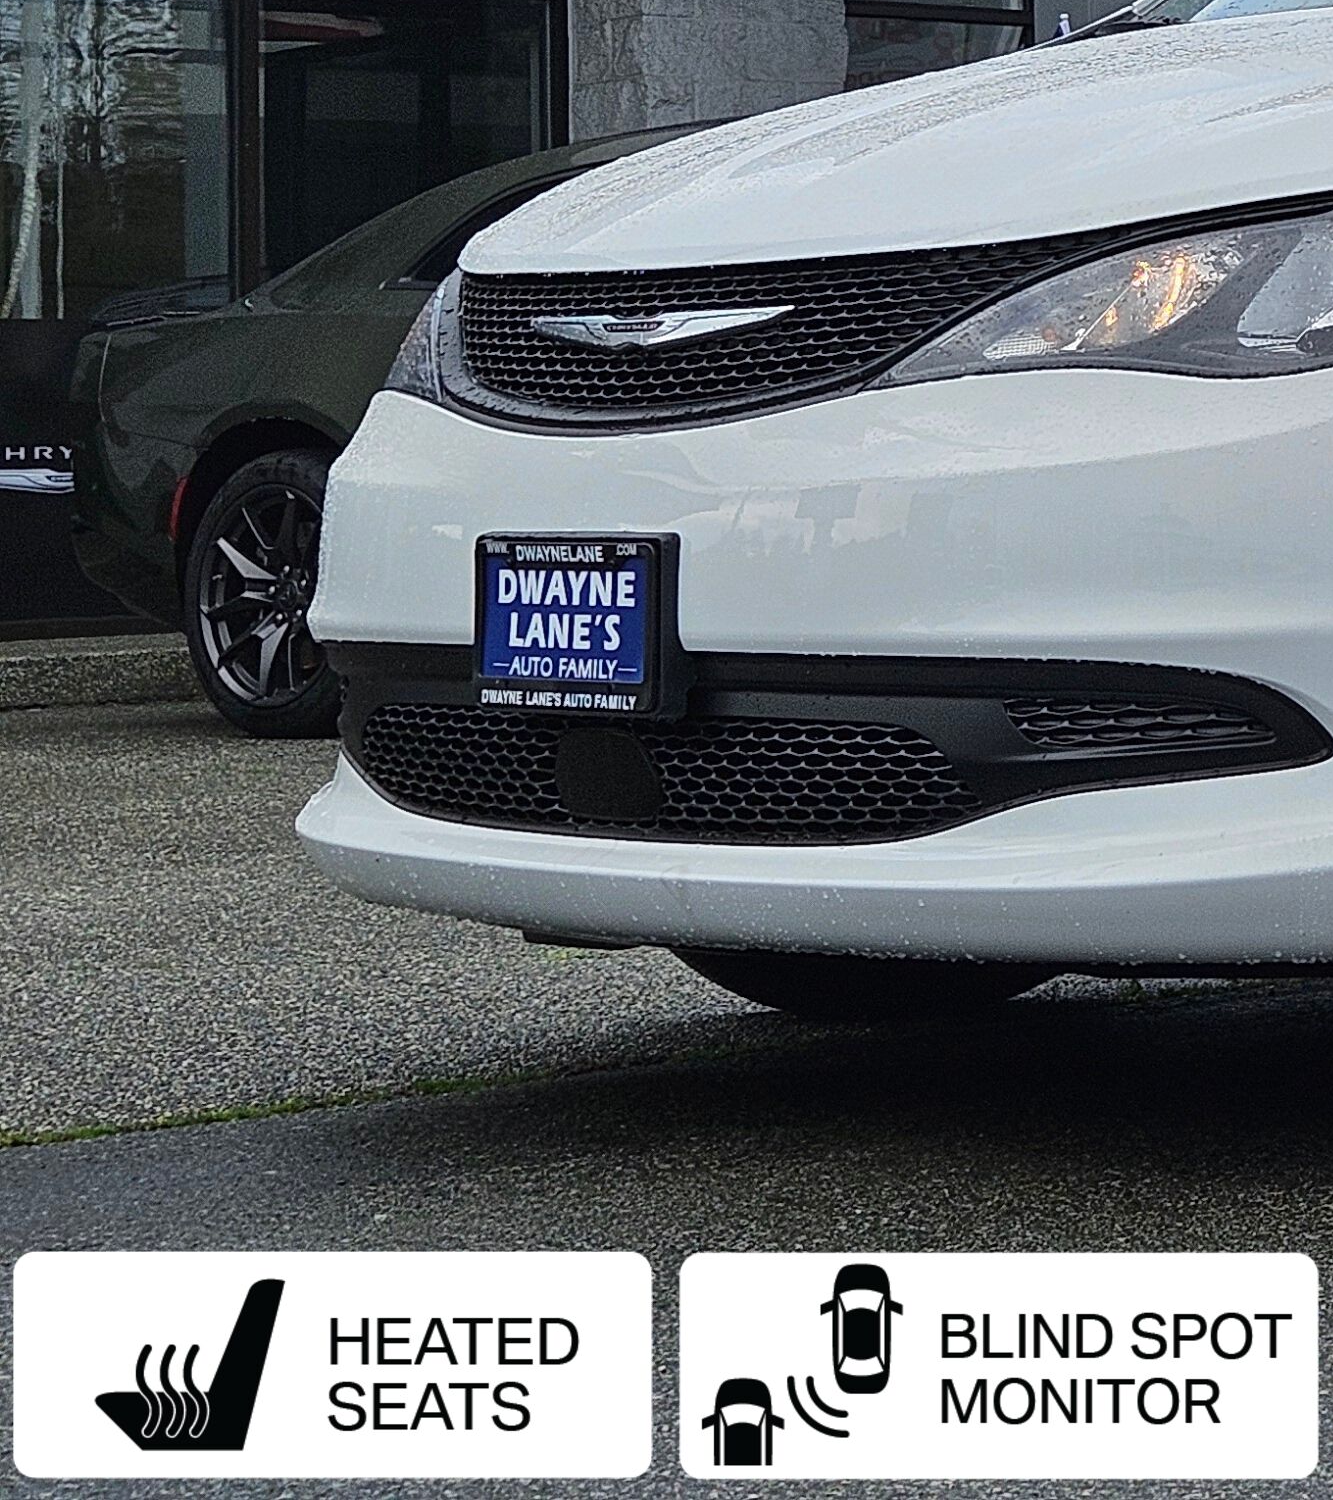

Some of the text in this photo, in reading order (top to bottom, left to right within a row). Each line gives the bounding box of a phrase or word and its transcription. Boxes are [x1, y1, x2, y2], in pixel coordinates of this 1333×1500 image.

[515, 545, 605, 563] DWAYNELANE
[497, 569, 636, 607] DWAYNE
[508, 612, 621, 651] LANE'S
[508, 656, 618, 680] AUTO FAMILY
[480, 689, 637, 711] DWAYNE LANE'S AUTO FAMILY
